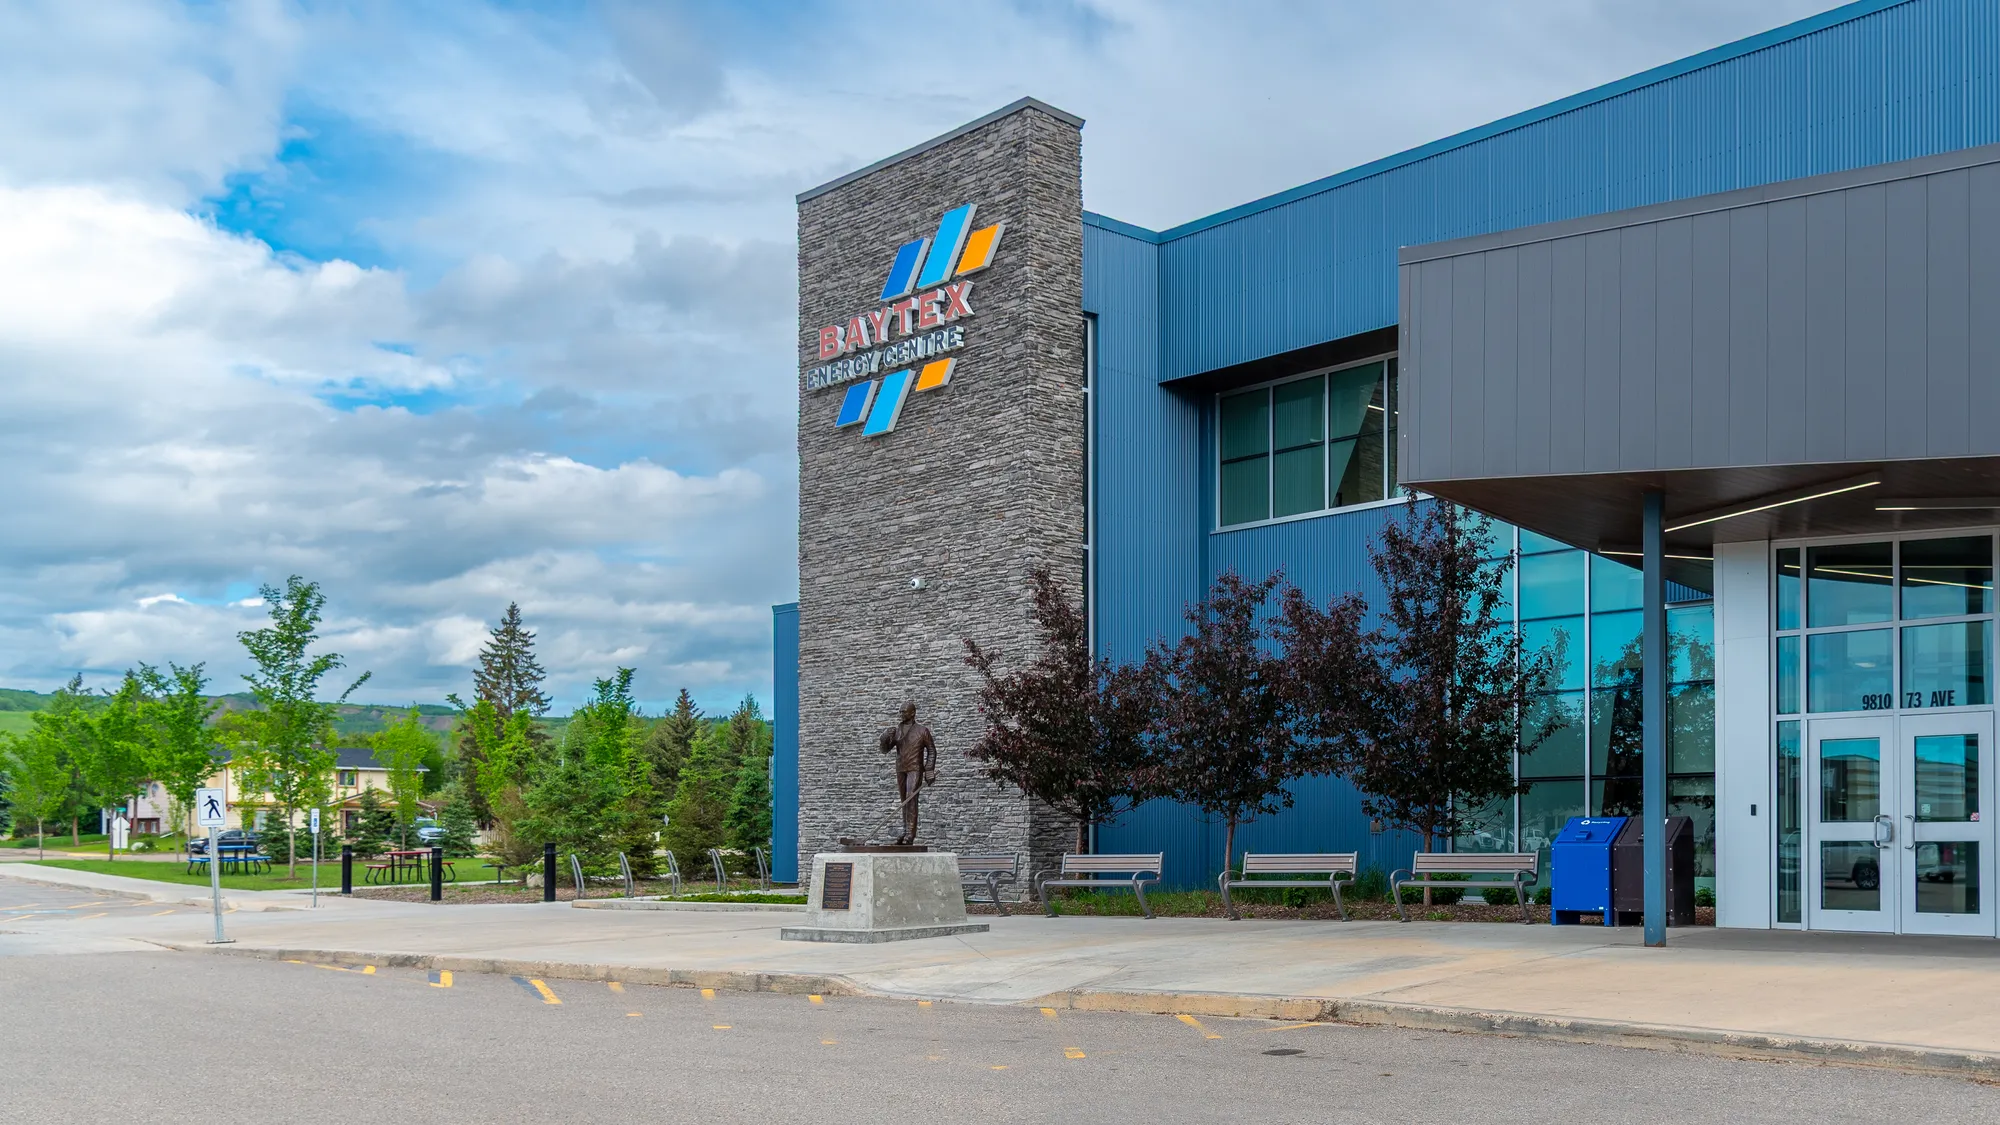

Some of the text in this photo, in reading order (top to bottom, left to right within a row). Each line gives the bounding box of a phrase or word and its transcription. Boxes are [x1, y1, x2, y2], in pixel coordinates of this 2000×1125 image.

[819, 280, 975, 360] BAYTEX
[806, 326, 964, 390] ENERGY CENTRE
[1862, 690, 1955, 710] 9810 73 AVE
